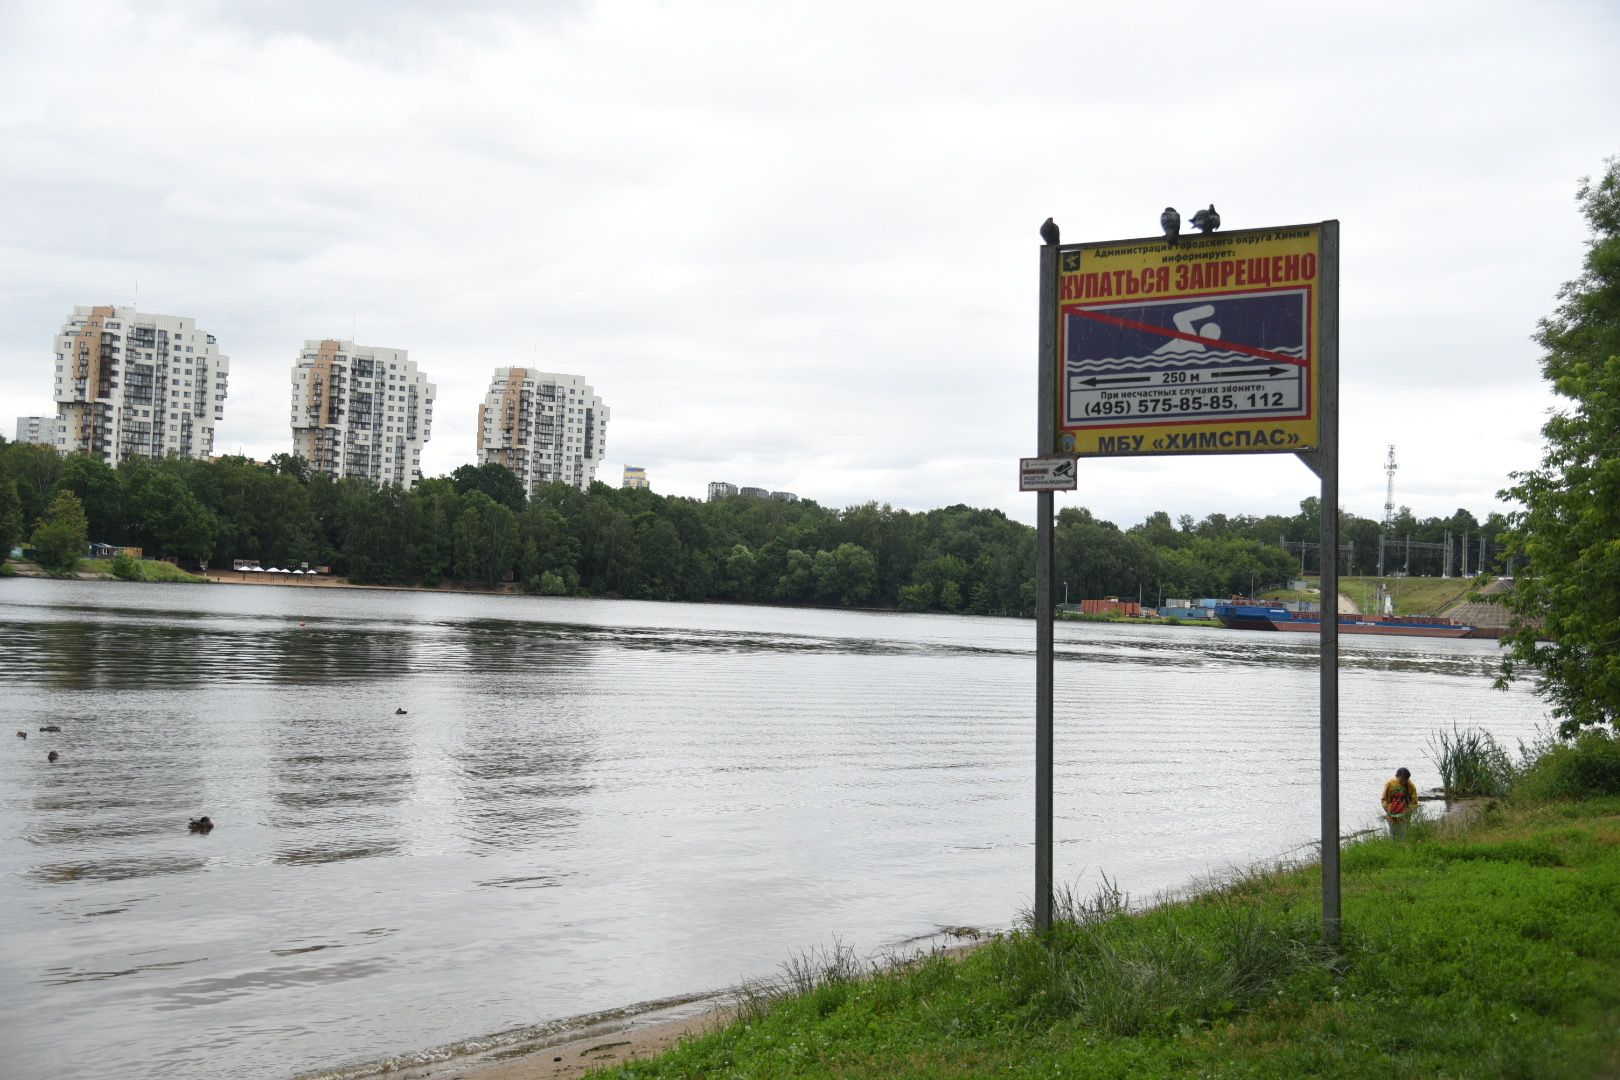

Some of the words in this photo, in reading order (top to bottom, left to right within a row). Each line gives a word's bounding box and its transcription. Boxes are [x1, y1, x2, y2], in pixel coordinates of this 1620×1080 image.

[1094, 244, 1173, 258] Администрация
[1236, 233, 1271, 245] округа
[1275, 230, 1310, 240] Химки
[1162, 249, 1235, 263] информирует:
[1060, 264, 1169, 301] КУПАТЬСЯ
[1175, 252, 1316, 293] ЗАПРЕЩЕНО
[1162, 372, 1186, 383] 250
[1084, 400, 1131, 416] (495)
[1138, 395, 1238, 413] 575-85-85,
[1247, 392, 1284, 407] 112
[1100, 391, 1119, 400] При
[1121, 388, 1176, 398] несчастных
[1179, 386, 1218, 397] случаях
[1221, 384, 1265, 393] звоните:
[1098, 435, 1144, 452] МБУ
[1153, 428, 1300, 449] «ХИМСПАС»
